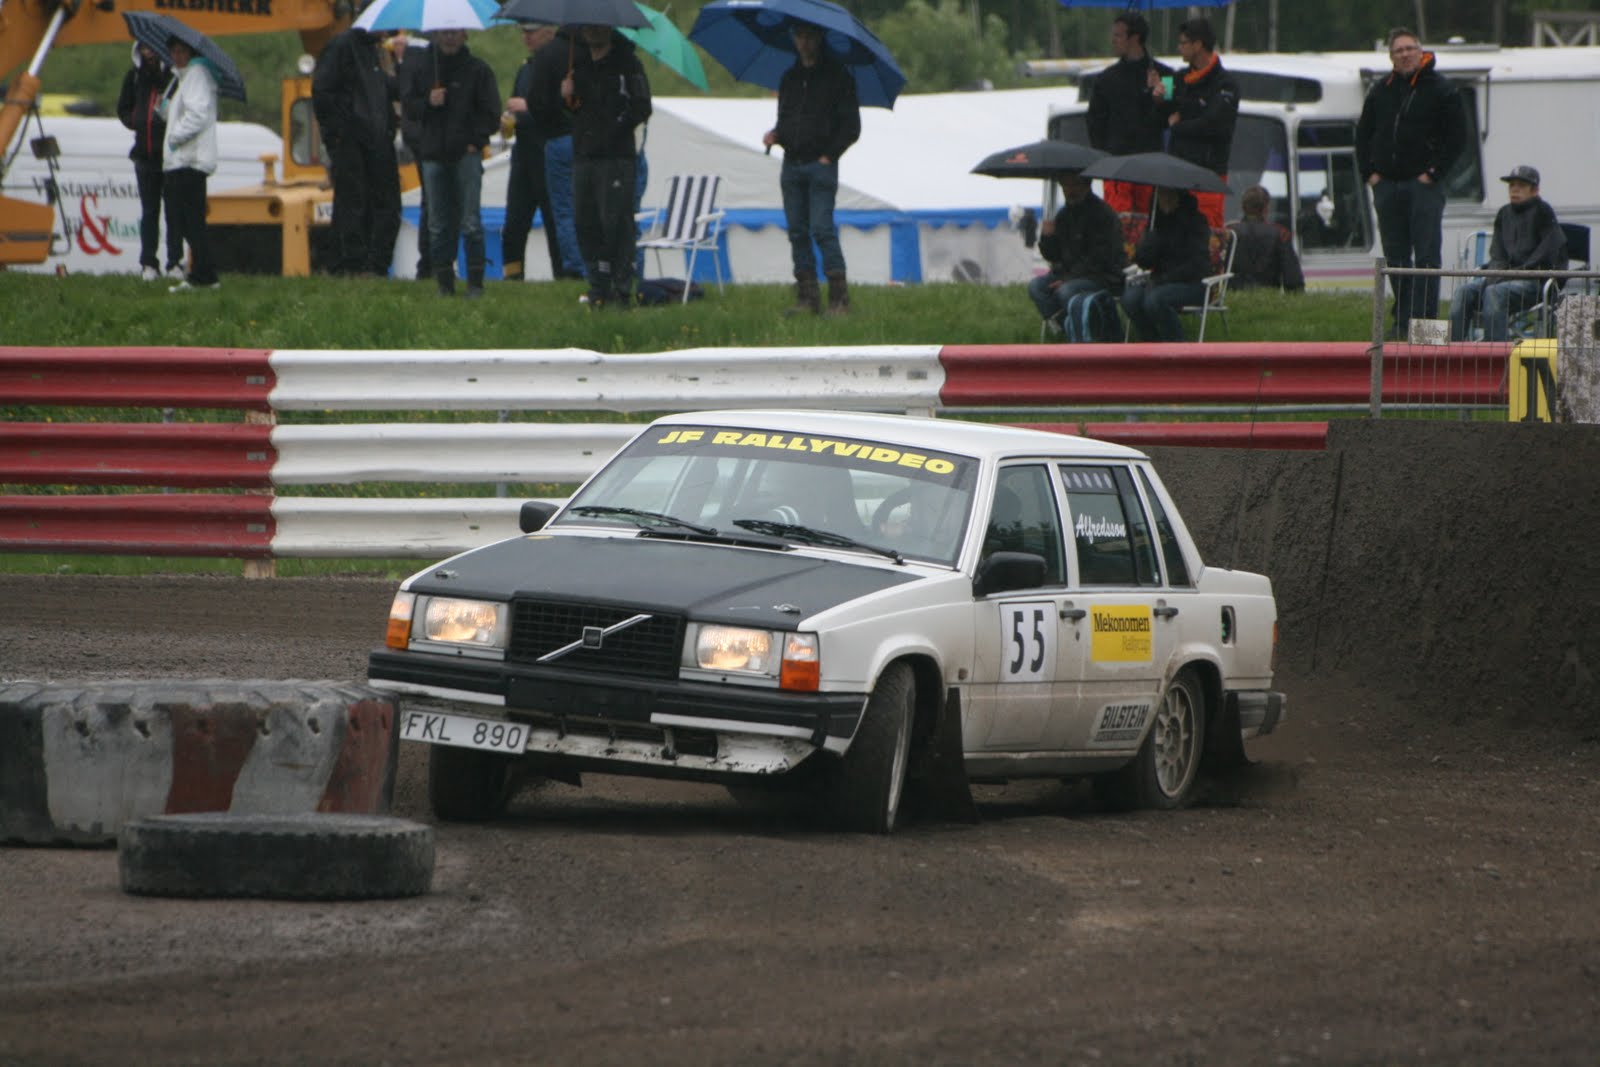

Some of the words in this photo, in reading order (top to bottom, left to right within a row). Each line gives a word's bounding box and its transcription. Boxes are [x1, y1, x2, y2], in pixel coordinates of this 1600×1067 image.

[657, 430, 704, 444] JF
[711, 430, 955, 474] RALLYVIDEO
[1075, 513, 1127, 544] Alfredsson
[1093, 613, 1150, 632] Mekonomen
[1010, 609, 1045, 675] 55
[405, 713, 451, 742] FKL
[473, 722, 522, 749] 890
[1100, 704, 1150, 729] BILSTEIN
